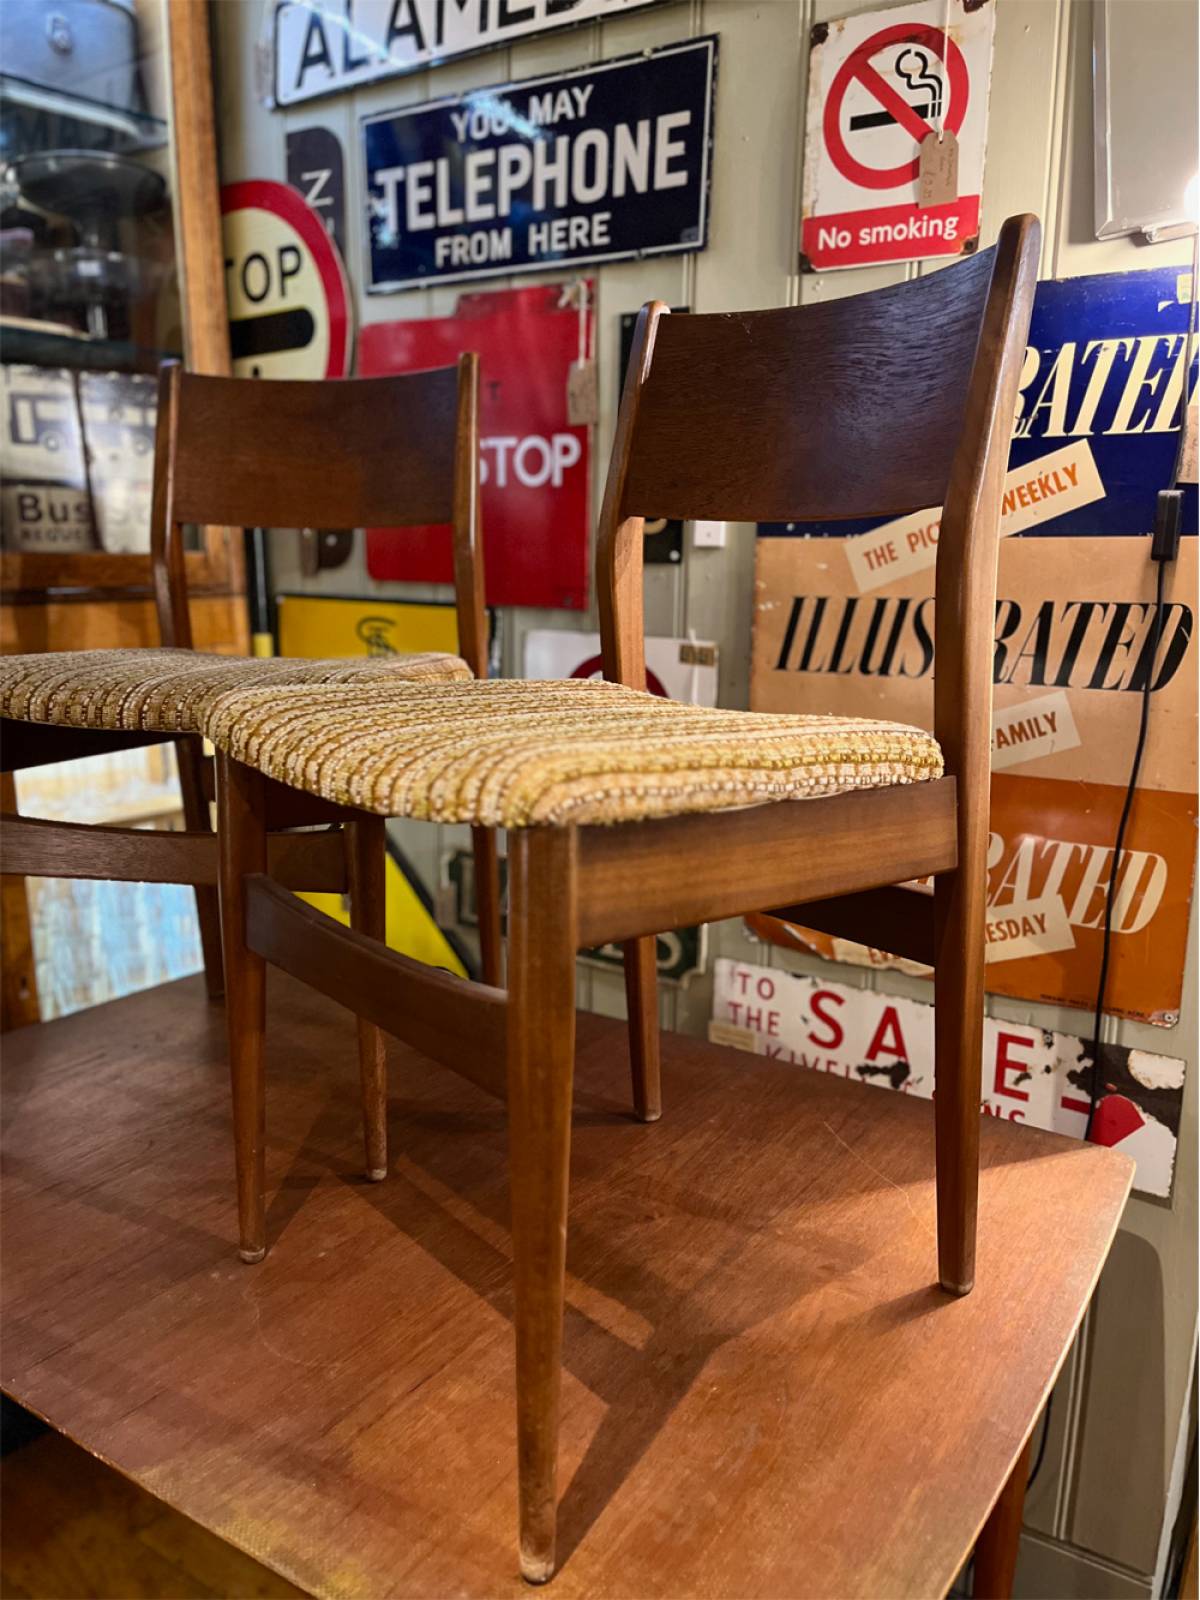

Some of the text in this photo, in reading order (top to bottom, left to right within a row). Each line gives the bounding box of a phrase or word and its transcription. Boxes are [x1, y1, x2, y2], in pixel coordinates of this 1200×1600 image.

[452, 85, 594, 142] YOU MAY
[374, 110, 692, 235] TELEPHONE
[435, 212, 612, 268] FROM HERE
[817, 214, 960, 251] No smoking
[863, 541, 899, 571] THE
[905, 520, 942, 554] PIC
[774, 596, 1194, 692] ILLUSRATED
[991, 711, 1057, 752] AMILY
[985, 912, 1047, 944] ESDAY
[736, 972, 776, 1000] TO
[728, 1001, 781, 1037] THE
[807, 989, 1035, 1103] SAE
